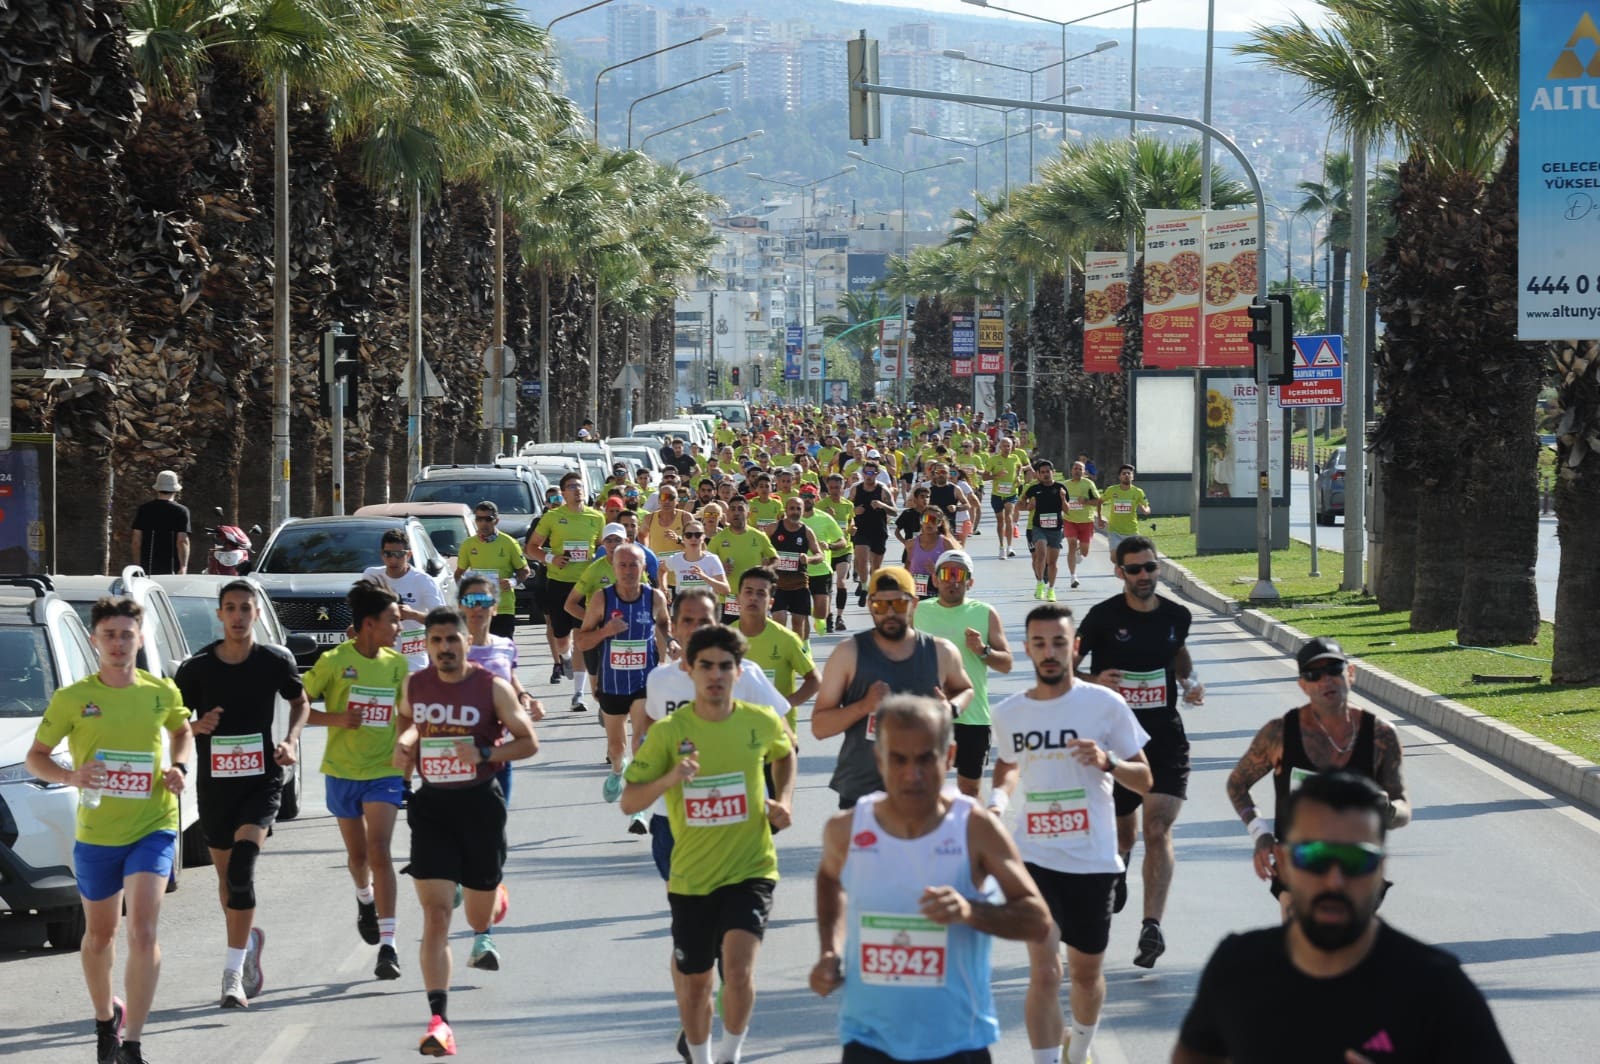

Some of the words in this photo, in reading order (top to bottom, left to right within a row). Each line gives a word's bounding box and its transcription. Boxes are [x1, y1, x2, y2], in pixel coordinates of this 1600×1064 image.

[1541, 161, 1600, 173] GELECE
[1544, 176, 1600, 190] YÜKSEL
[1526, 275, 1570, 295] 444
[1576, 274, 1590, 294] 0
[1293, 369, 1316, 378] RAMVAY
[1288, 388, 1334, 397] İÇERİSİNDE
[1281, 396, 1341, 405] BEKLEMEYİNİZ
[613, 654, 643, 665] 36153
[1122, 688, 1162, 703] 36212
[412, 703, 481, 726] BOLD
[1012, 729, 1079, 753] BOLD
[216, 754, 259, 770] 36136
[690, 797, 741, 818] 36411
[1030, 812, 1085, 832] 35389
[865, 947, 940, 974] 35942
